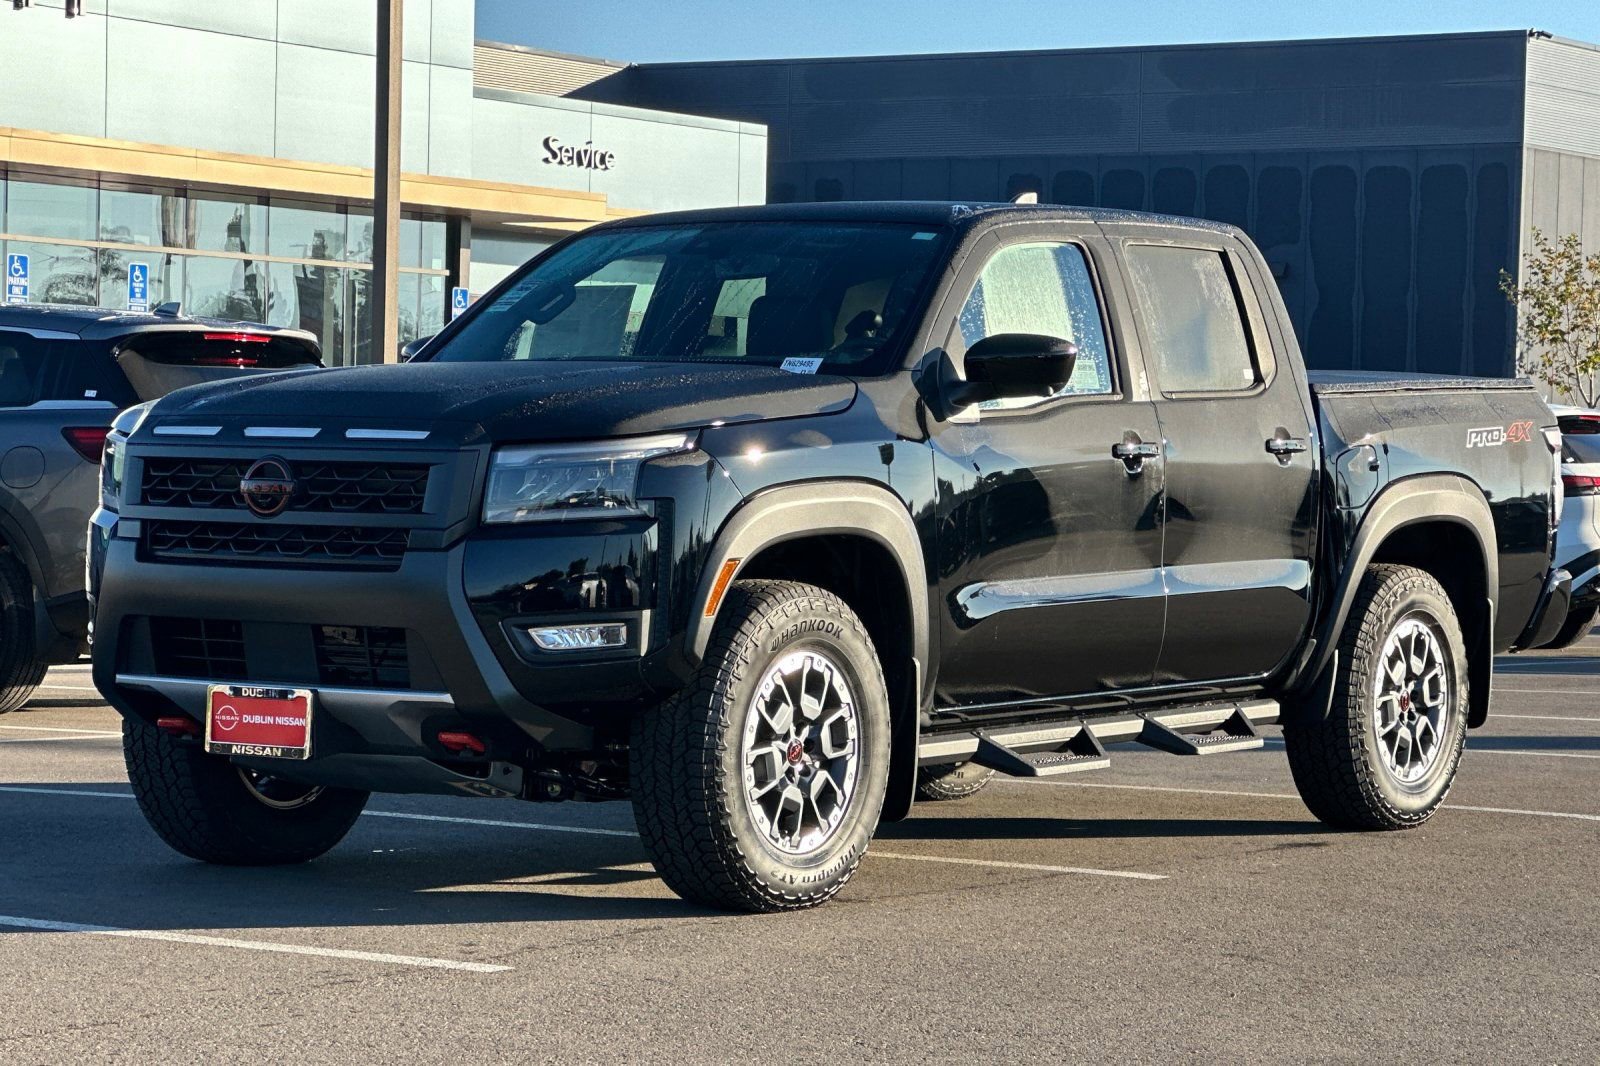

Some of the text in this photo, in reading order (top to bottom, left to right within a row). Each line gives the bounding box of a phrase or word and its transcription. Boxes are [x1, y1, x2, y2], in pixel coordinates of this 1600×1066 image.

[541, 135, 616, 171] Service
[215, 714, 240, 722] NISSAN
[242, 714, 306, 727] DUBLIN NISSAN
[231, 744, 282, 757] NISSAN
